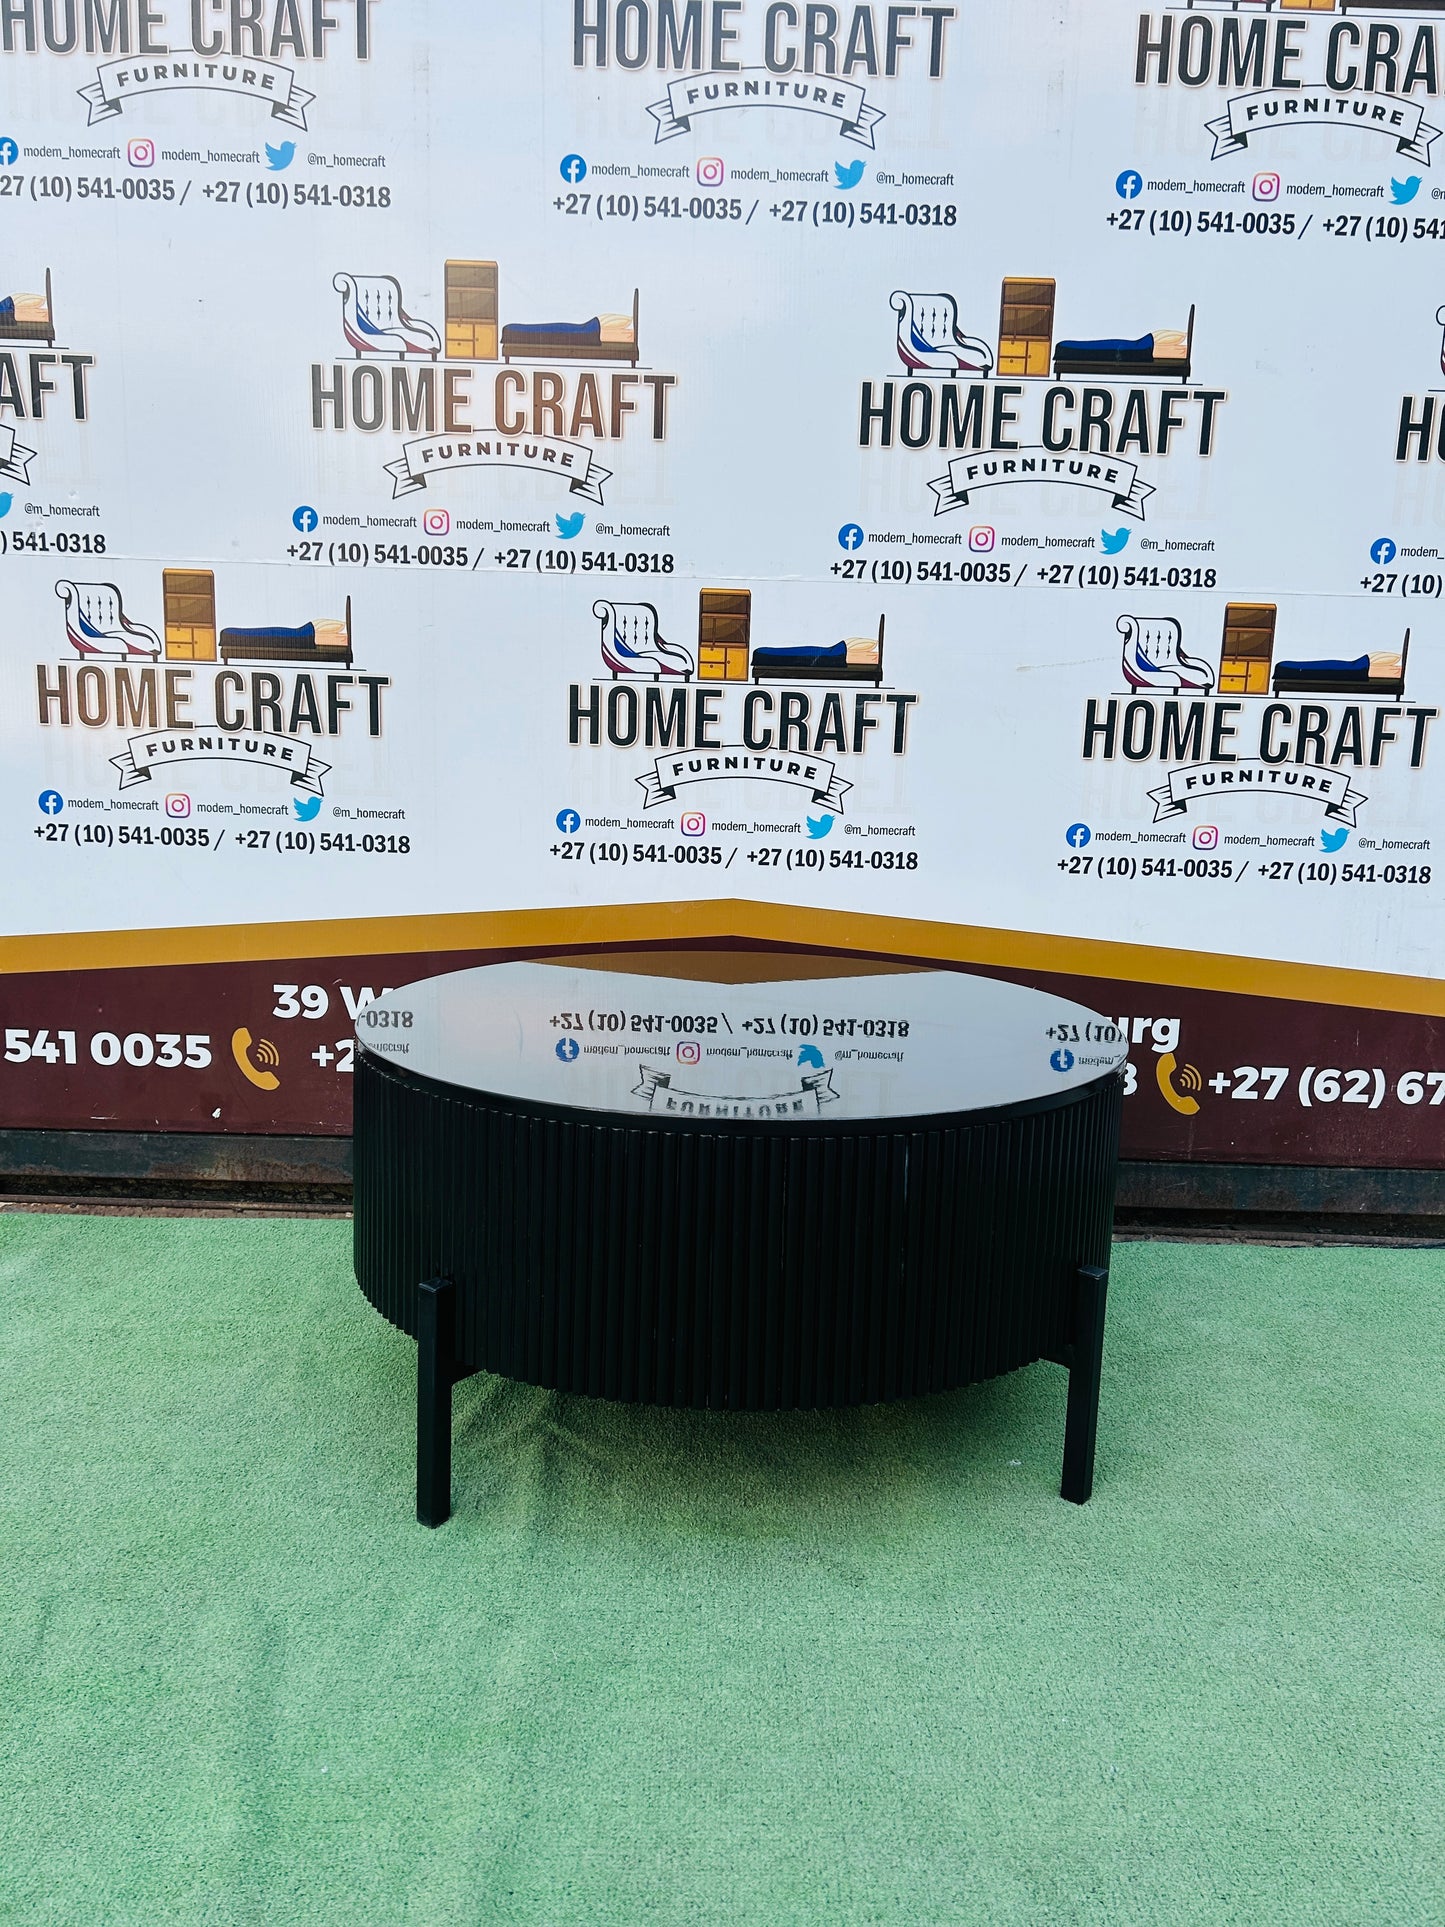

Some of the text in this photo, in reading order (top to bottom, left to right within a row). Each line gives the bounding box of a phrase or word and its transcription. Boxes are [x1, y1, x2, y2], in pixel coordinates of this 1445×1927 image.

[2, 0, 168, 55] HOME
[574, 0, 955, 77] HOME CRAFT
[1135, 14, 1305, 89] HOME
[117, 63, 275, 90] FURNITURE
[687, 81, 846, 108] FURNITURE
[1246, 98, 1404, 126] FURNITURE
[307, 153, 386, 168] @m_homecraft
[30, 176, 72, 202] (10)
[77, 177, 175, 201] 541-0035
[202, 181, 240, 203] +27
[246, 182, 288, 209] (10)
[293, 184, 391, 208] 541-0318
[876, 172, 954, 187] @m_homecraft
[553, 193, 591, 215] +27
[597, 194, 638, 221] (10)
[644, 196, 742, 220] 541-0035
[769, 200, 808, 222] +27
[813, 201, 855, 228] (10)
[860, 203, 957, 226] 541-0318
[1106, 209, 1145, 230] +27
[1150, 210, 1192, 237] (10)
[1197, 211, 1295, 235] 541-0035
[1323, 215, 1361, 236] +27
[1366, 216, 1408, 243] (10)
[311, 364, 677, 440] HOME CRAFT
[859, 382, 1227, 457] HOME CRAFT
[422, 442, 574, 468] FURNITURE
[967, 459, 1119, 484] FURNITURE
[24, 503, 100, 517] @m_homecraft
[13, 531, 106, 554] 541-0318
[596, 523, 670, 537] @m_homecraft
[287, 541, 323, 561] +27
[329, 543, 369, 567] (10)
[374, 544, 468, 566] 541-0035
[494, 549, 531, 568] +27
[536, 550, 576, 574] (10)
[581, 551, 674, 573] 541-0318
[1140, 538, 1215, 552] @m_homecraft
[830, 559, 867, 579] +27
[872, 560, 912, 584] (10)
[917, 561, 1010, 583] 541-0035
[1037, 564, 1074, 584] +27
[1078, 565, 1119, 589] (10)
[1123, 567, 1216, 588] 541-0318
[1360, 573, 1442, 598] +27 (10)
[36, 664, 391, 737] HOME CRAFT
[570, 683, 918, 753] HOME CRAFT
[1082, 698, 1437, 768] HOME CRAFT
[146, 738, 294, 762] FURNITURE
[673, 753, 819, 782] FURNITURE
[1186, 770, 1333, 793] FURNITURE
[333, 807, 405, 820] @m_homecraft
[34, 823, 69, 841] +27
[75, 824, 113, 847] (10)
[118, 826, 209, 847] 541-0035
[235, 830, 270, 848] +27
[276, 831, 315, 854] (10)
[320, 833, 410, 854] 541-0318
[844, 824, 916, 837] @m_homecraft
[1358, 838, 1430, 851] @m_homecraft
[550, 842, 585, 860] +27
[590, 843, 628, 865] (10)
[633, 844, 722, 864] 541-0035
[747, 848, 782, 866] +27
[787, 849, 824, 871] (10)
[829, 850, 918, 870] 541-0318
[1057, 856, 1093, 874] +27
[1098, 857, 1136, 879] (10)
[1141, 858, 1232, 878] 541-0035
[1258, 862, 1294, 880] +27
[1298, 863, 1337, 885] (10)
[1341, 864, 1431, 884] 541-0318
[273, 984, 328, 1019] 39
[4, 1029, 212, 1068] 541 0035
[1208, 1066, 1289, 1100] +27
[1299, 1067, 1385, 1109] (62)
